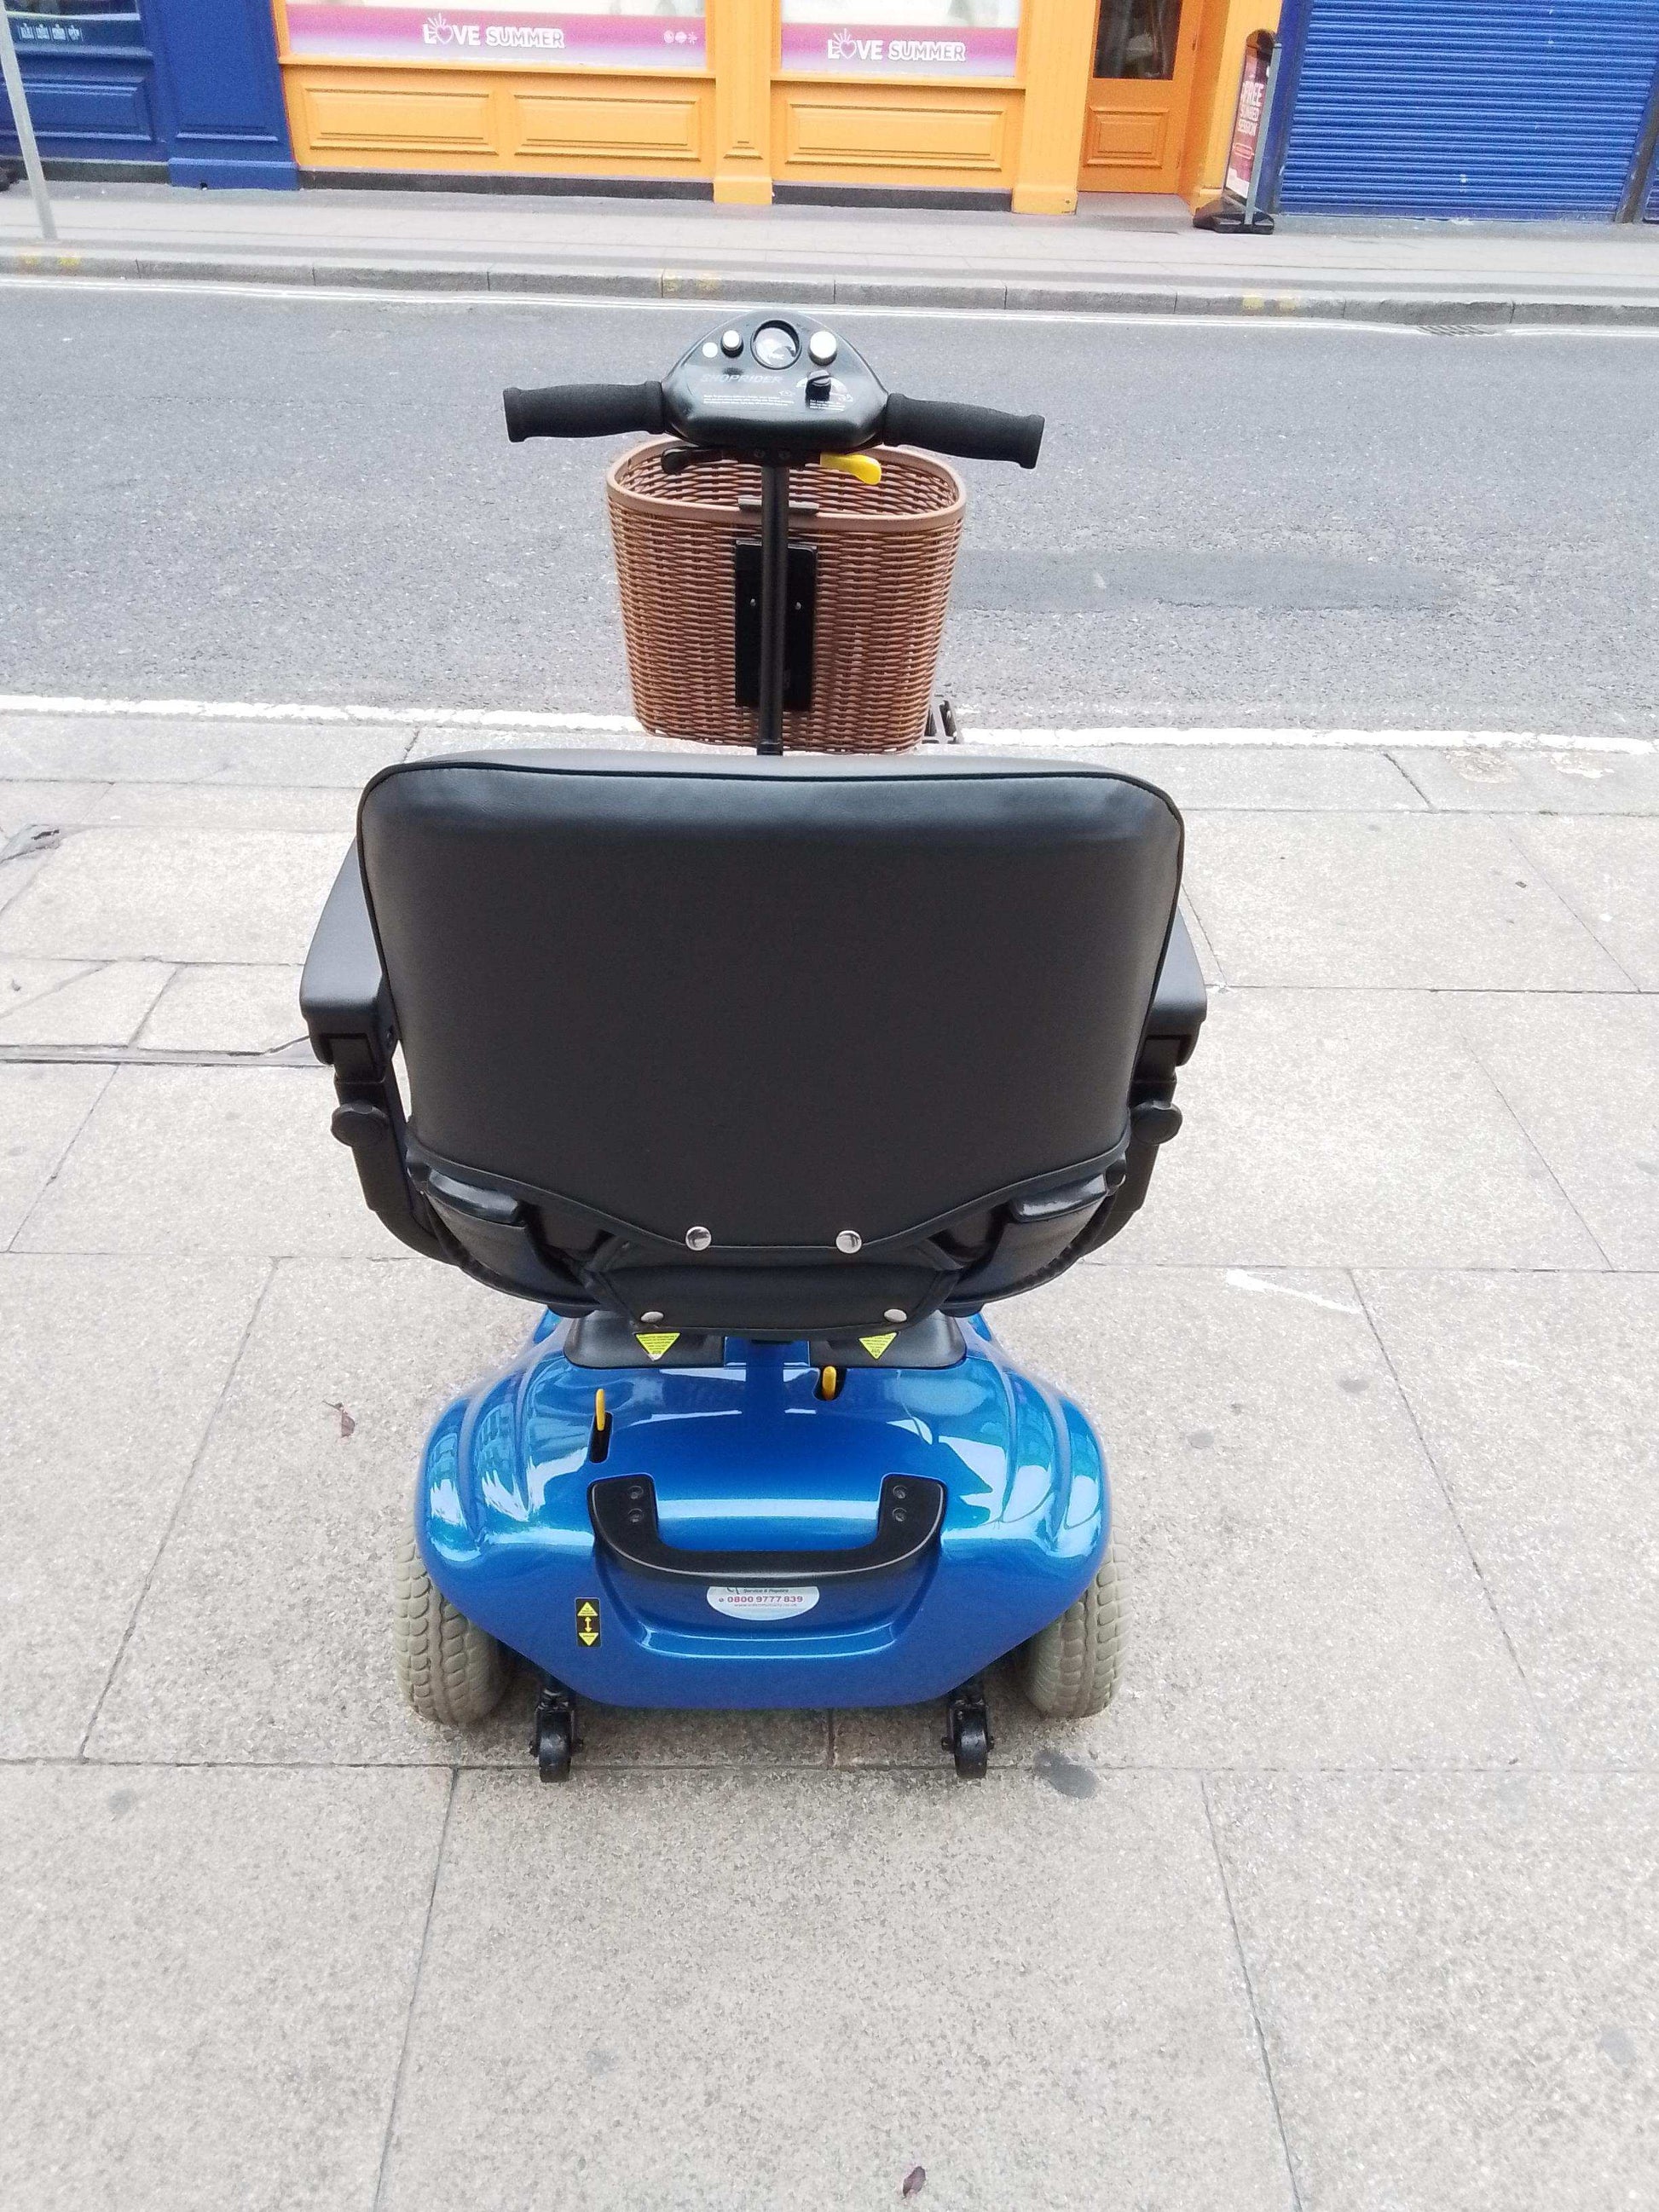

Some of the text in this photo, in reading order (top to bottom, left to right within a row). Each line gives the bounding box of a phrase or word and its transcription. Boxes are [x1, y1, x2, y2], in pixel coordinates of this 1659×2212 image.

[423, 18, 565, 49] LOVE SUMMER
[827, 33, 966, 62] LOVE SUMMER
[700, 373, 783, 384] SHOPRIDER
